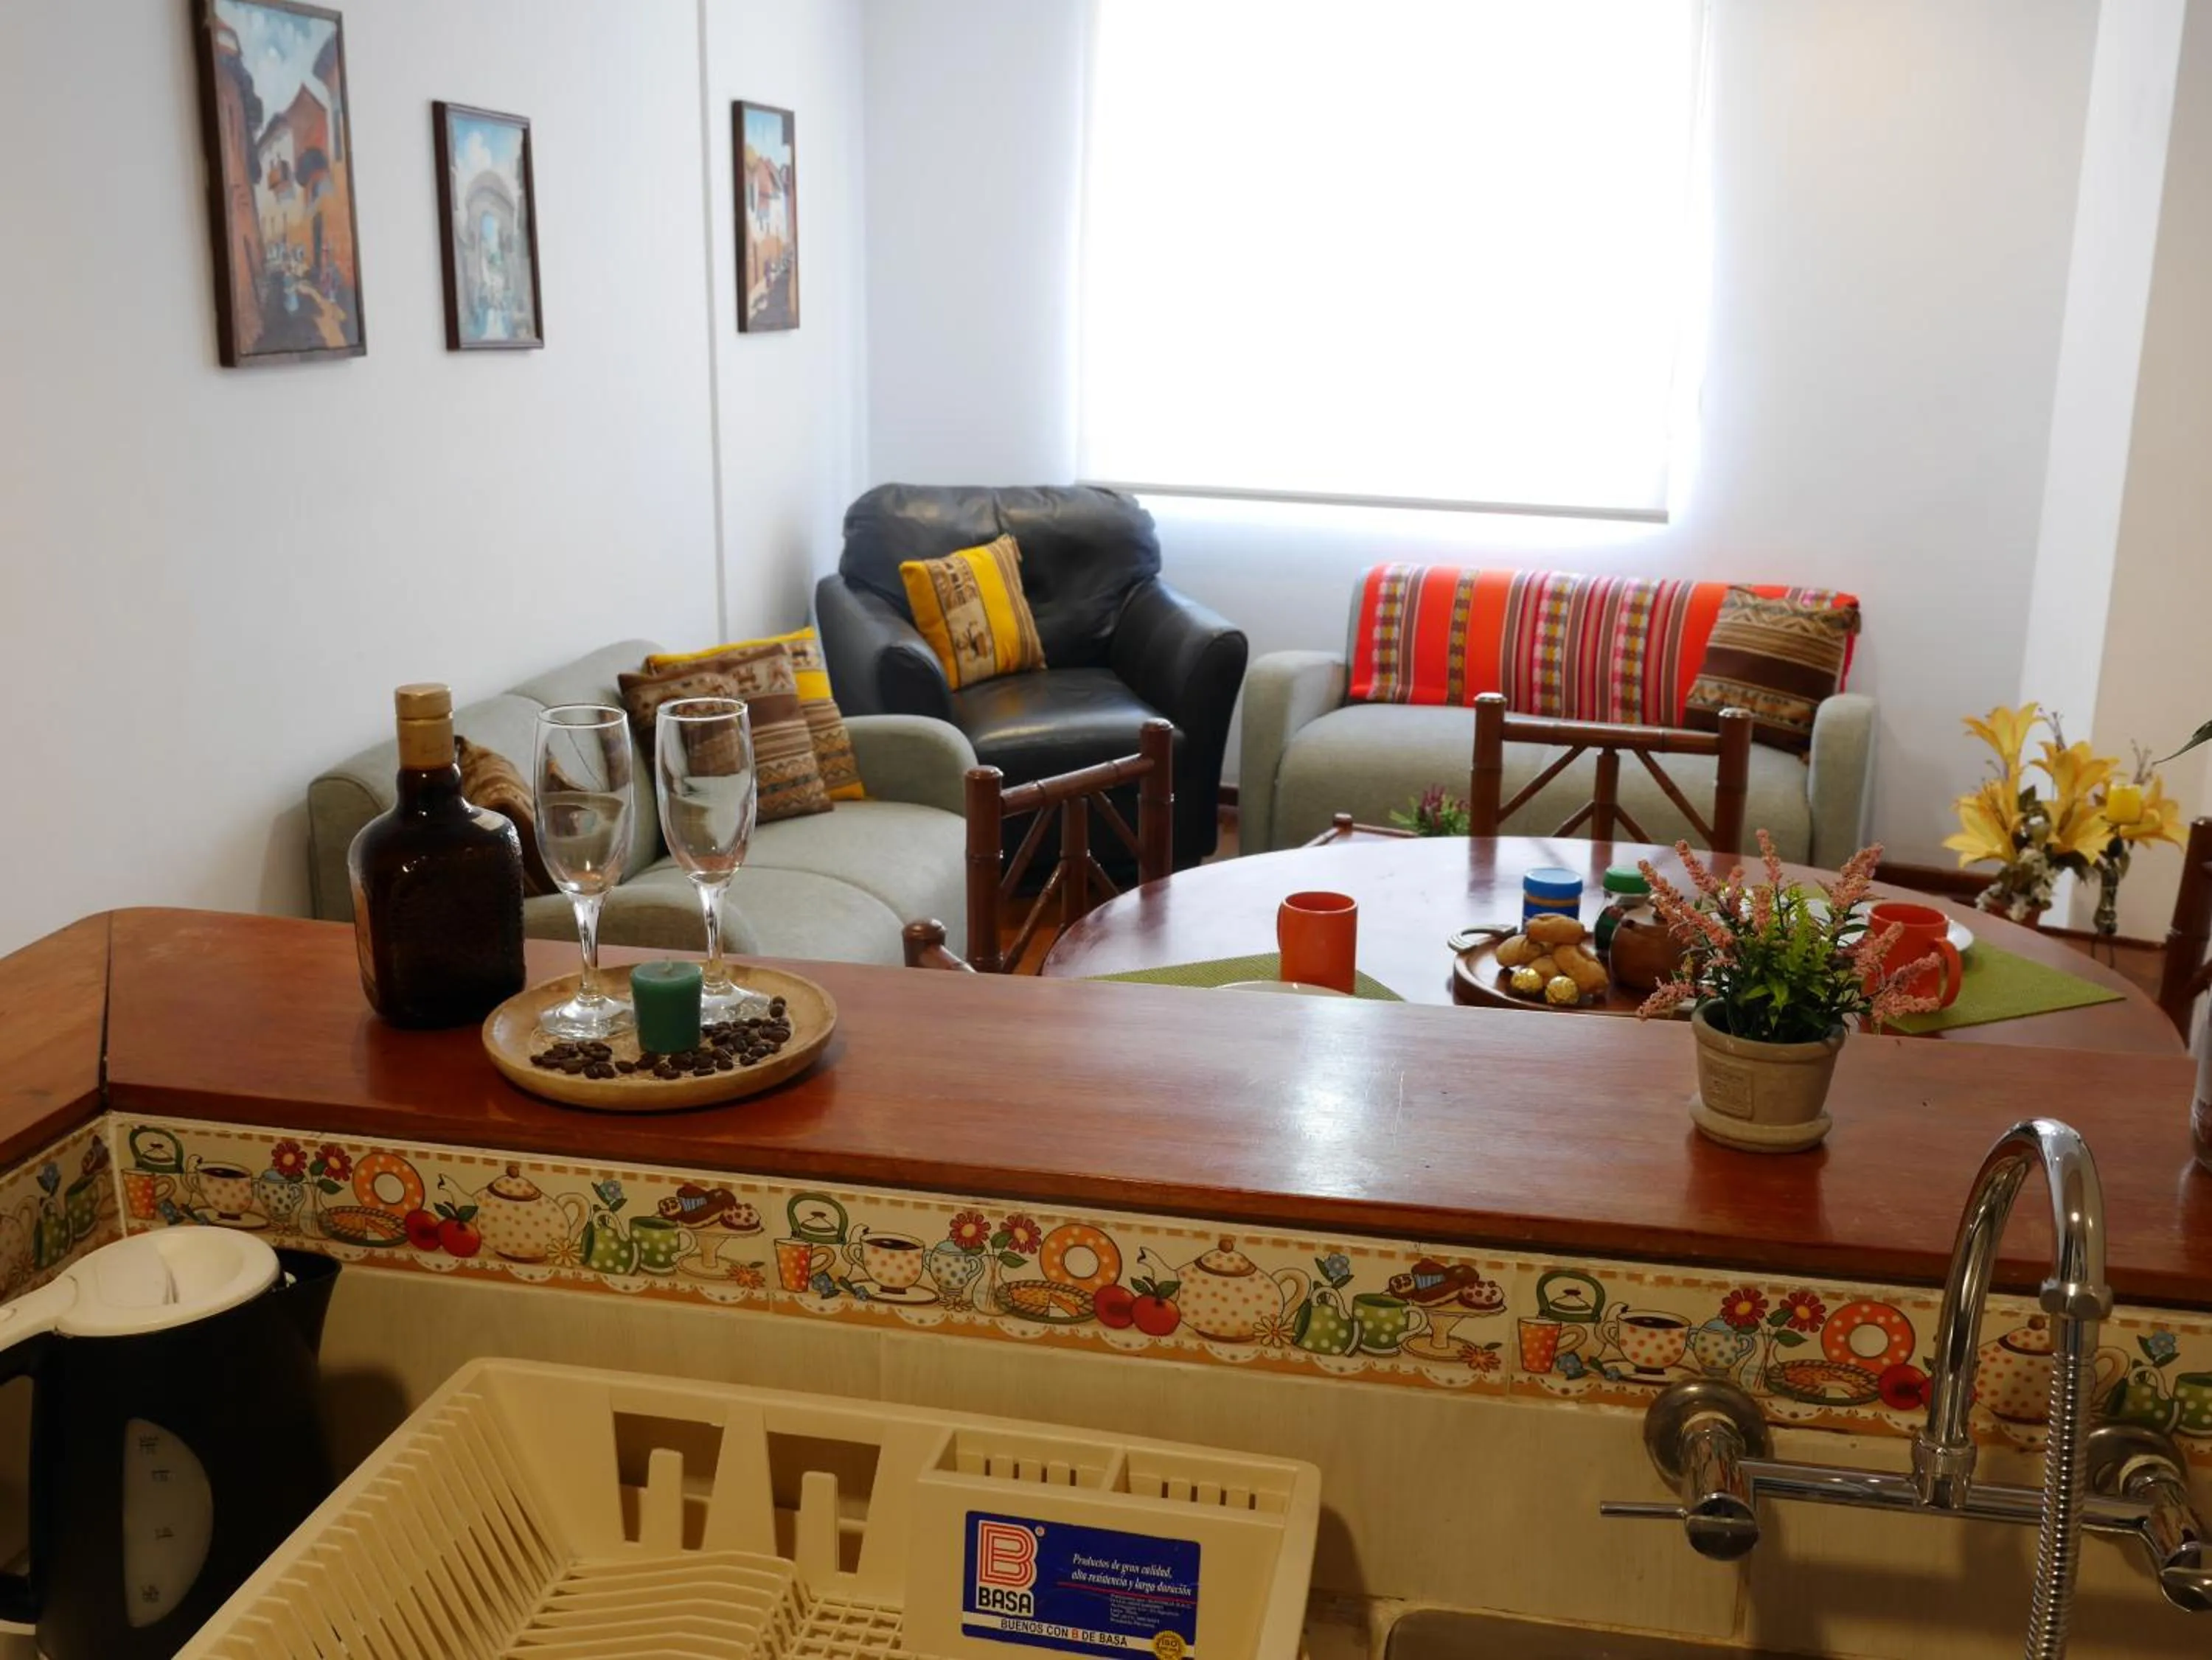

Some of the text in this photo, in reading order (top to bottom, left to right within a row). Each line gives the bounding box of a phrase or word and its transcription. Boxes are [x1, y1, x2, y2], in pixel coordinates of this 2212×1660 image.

[1073, 1553, 1110, 1569] Productos
[1111, 1559, 1120, 1570] de
[1121, 1562, 1139, 1576] gran
[1071, 1569, 1087, 1581] alta
[1088, 1572, 1127, 1587] resistencia
[978, 1586, 1032, 1614] BASA
[1001, 1619, 1127, 1647] BUENOS CON B DE BASA
[1161, 1639, 1178, 1647] ISO
